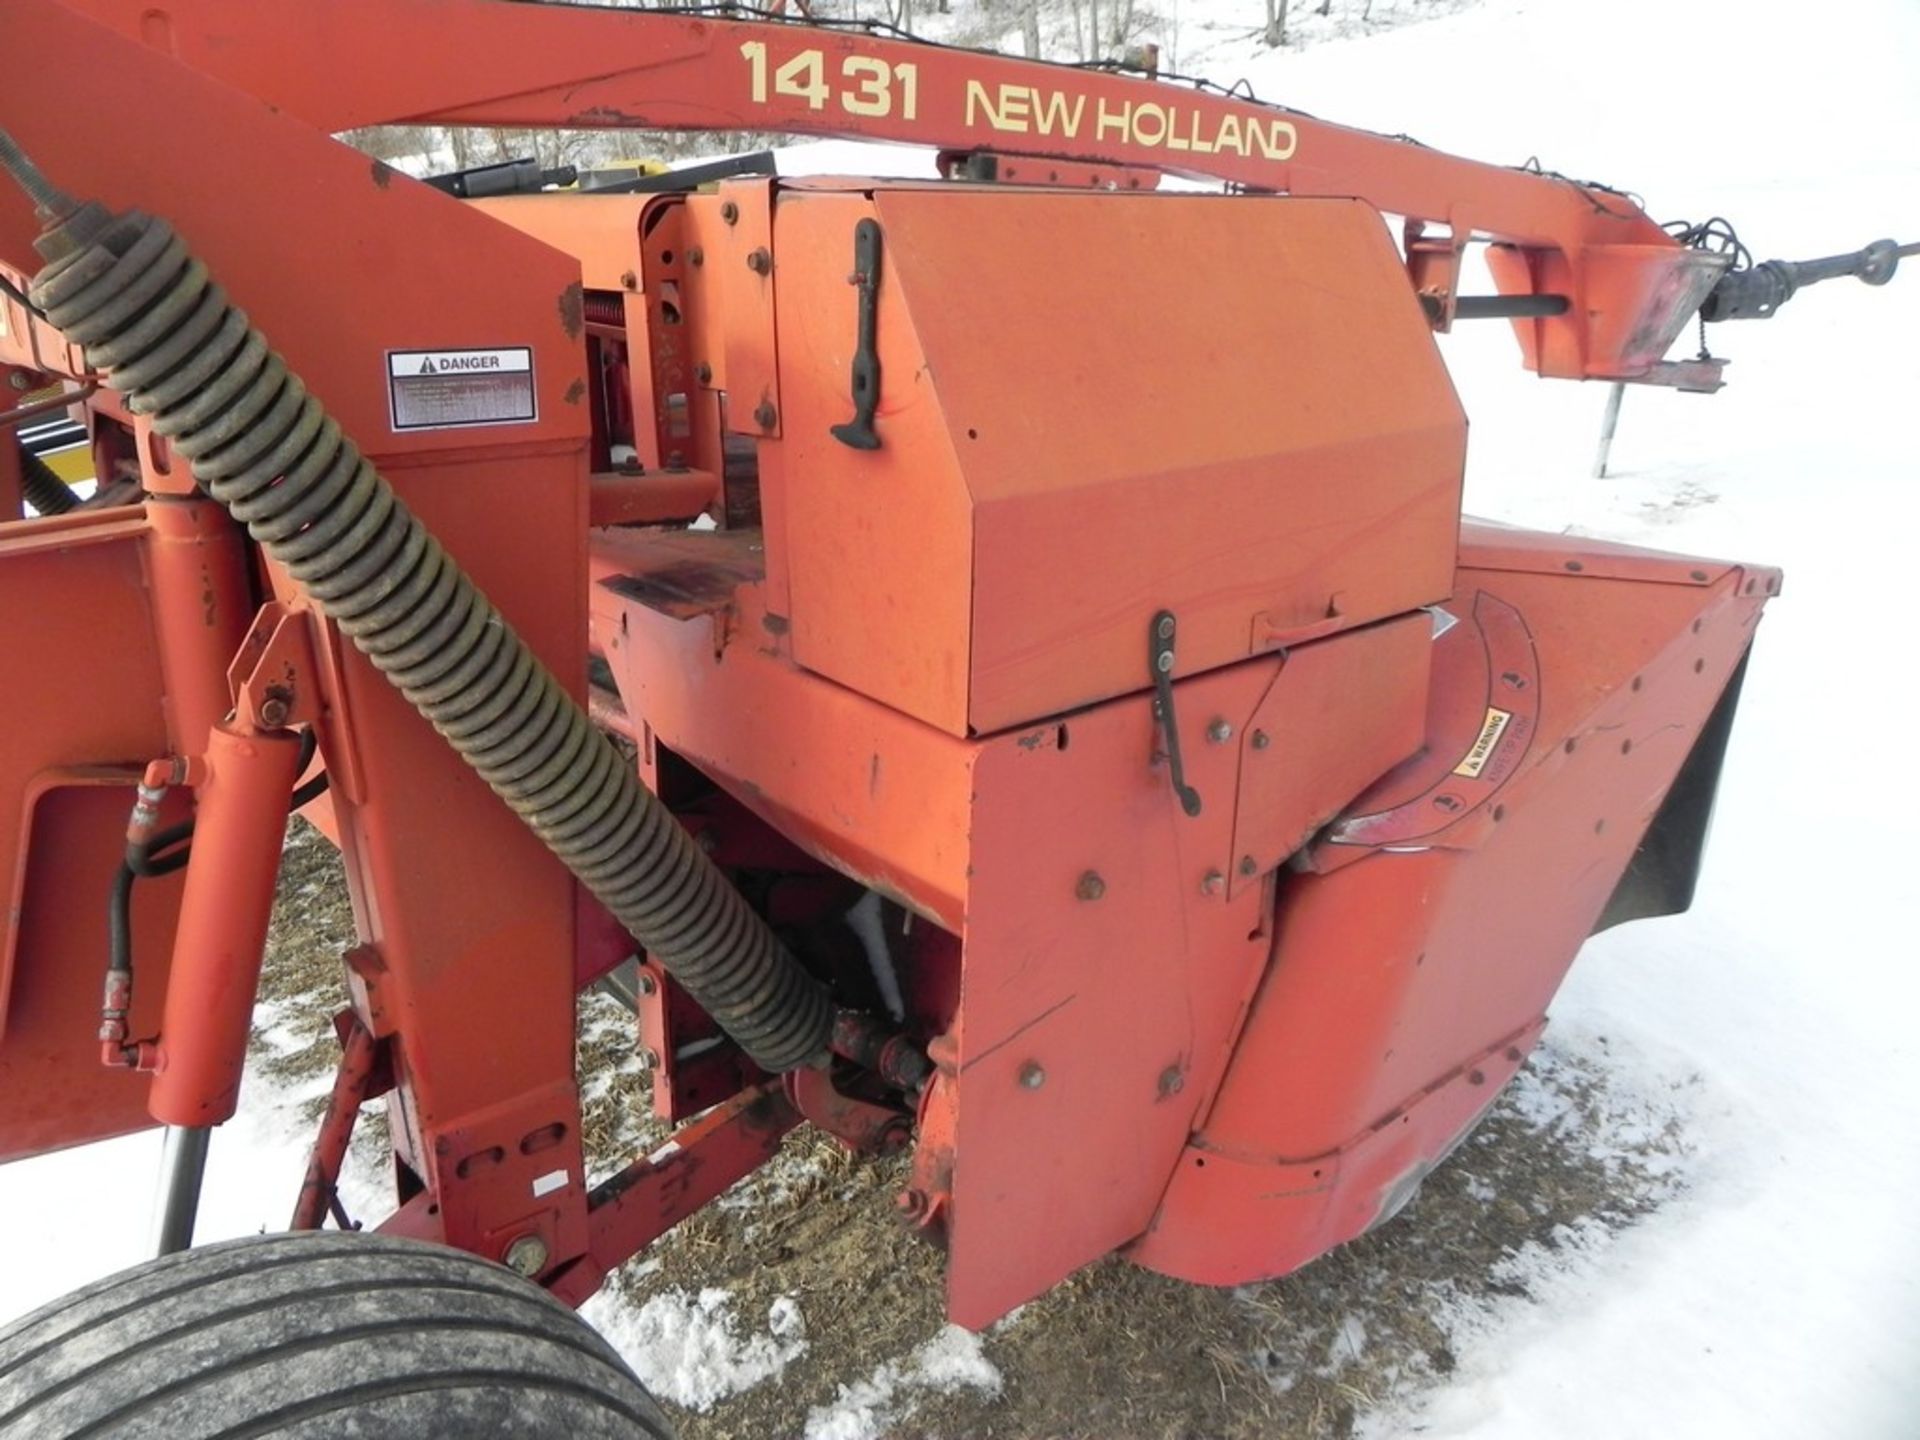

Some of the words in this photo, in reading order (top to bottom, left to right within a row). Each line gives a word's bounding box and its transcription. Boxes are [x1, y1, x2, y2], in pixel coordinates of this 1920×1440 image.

[739, 40, 917, 120] 1431
[965, 79, 1085, 138] NEW
[1096, 99, 1297, 161] HOLLAND
[439, 356, 500, 370] DANGER
[1470, 715, 1504, 758] WARNING
